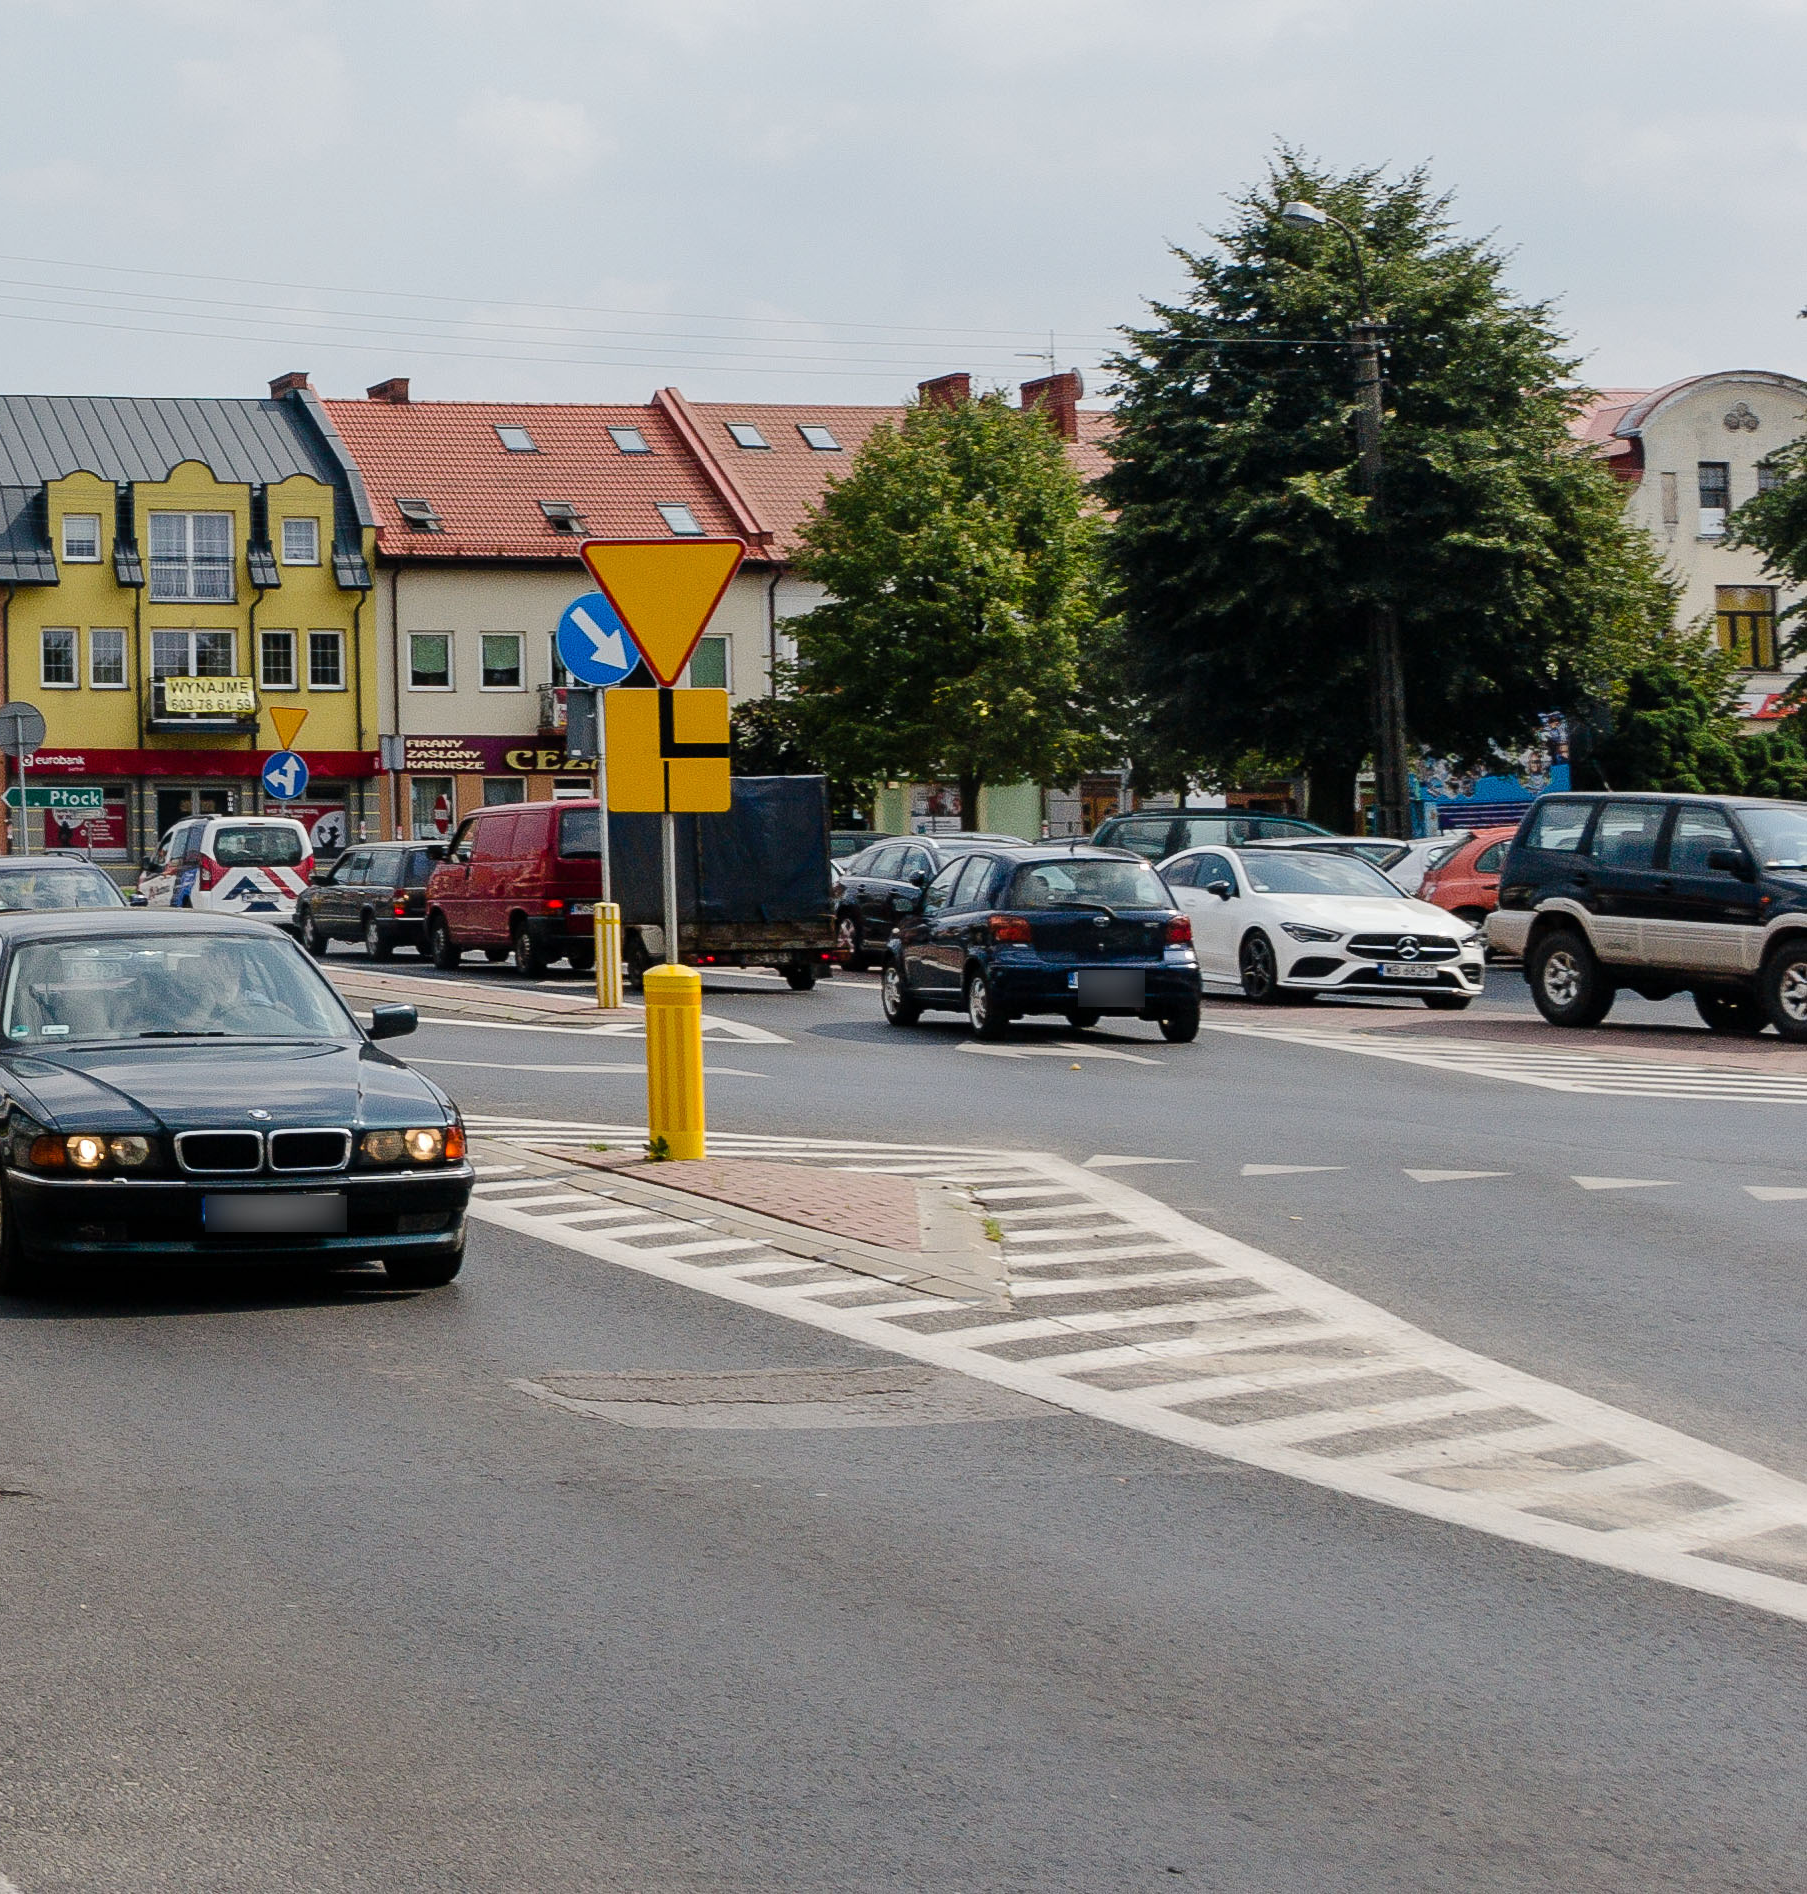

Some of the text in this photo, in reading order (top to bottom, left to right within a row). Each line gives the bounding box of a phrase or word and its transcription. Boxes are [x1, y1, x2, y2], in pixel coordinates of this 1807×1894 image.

[170, 682, 249, 696] WYNAJMĘ
[406, 739, 464, 748] FIRANY
[35, 755, 85, 765] eurobank
[406, 761, 486, 770] KARNISZE
[50, 790, 100, 805] Płock
